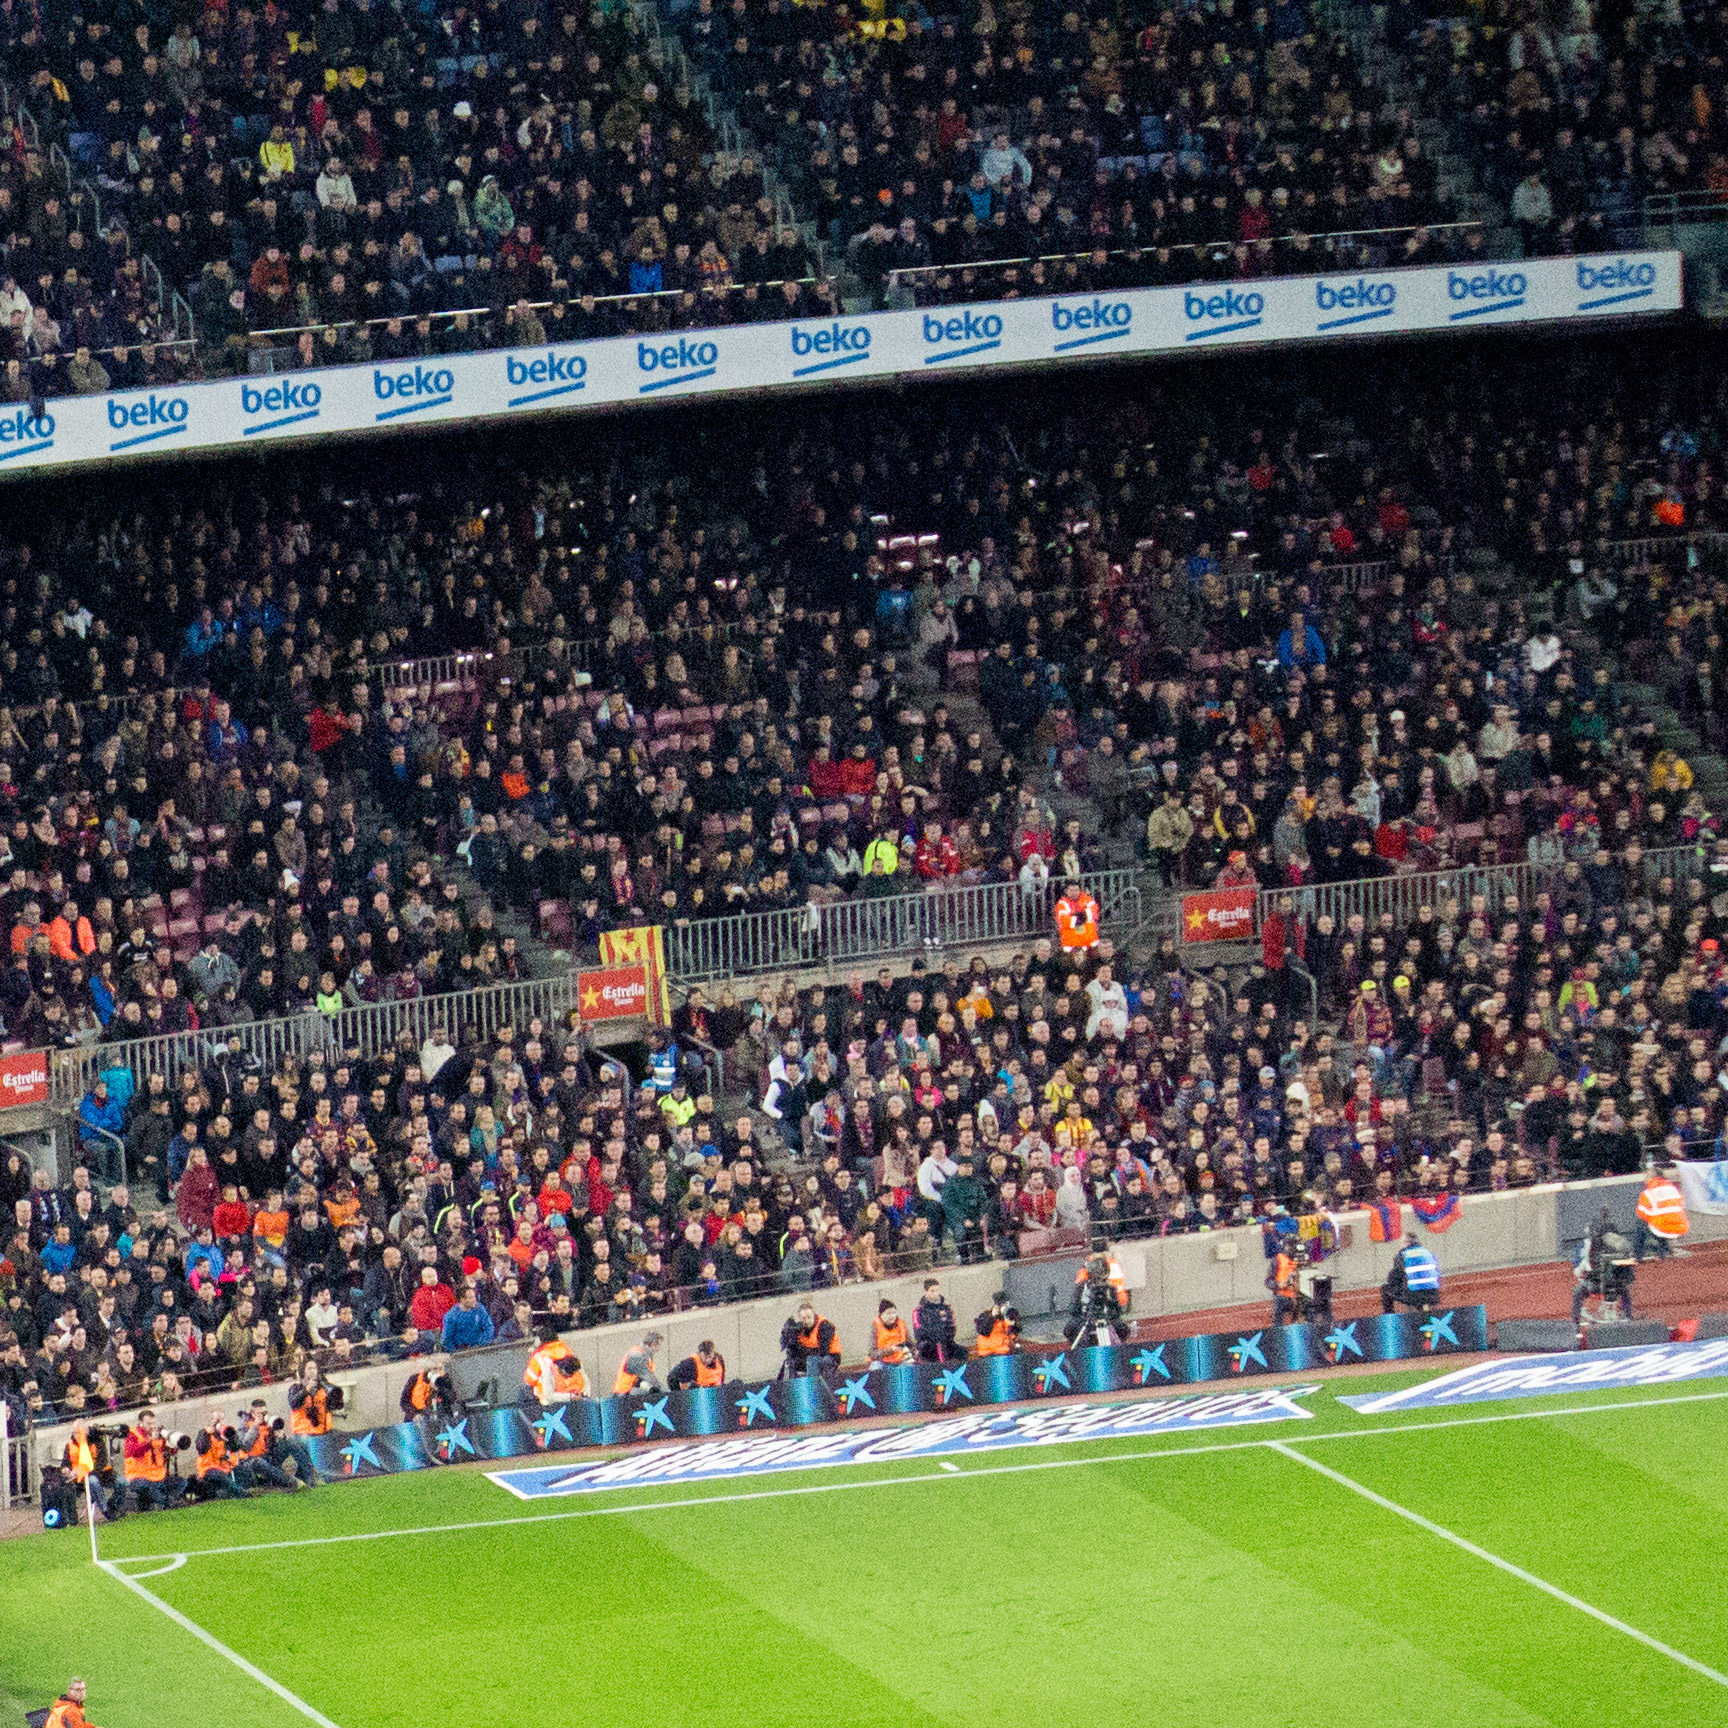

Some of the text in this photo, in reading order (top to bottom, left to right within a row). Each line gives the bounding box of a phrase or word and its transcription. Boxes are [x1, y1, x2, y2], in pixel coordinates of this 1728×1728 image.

[1447, 269, 1529, 301] beko
[1576, 259, 1656, 291] beko
[1183, 288, 1266, 322] beko
[1315, 278, 1397, 311] beko
[922, 310, 1004, 345] beko
[1051, 298, 1133, 332] beko
[636, 337, 719, 373] beko
[790, 322, 872, 357] beko
[373, 365, 455, 401] beko
[506, 351, 588, 387] beko
[106, 394, 190, 430] beko
[241, 379, 322, 415] beko
[602, 982, 646, 1000] Estrella
[2, 1069, 46, 1088] Estrella
[546, 1383, 1324, 1488] Allianz Seguros
